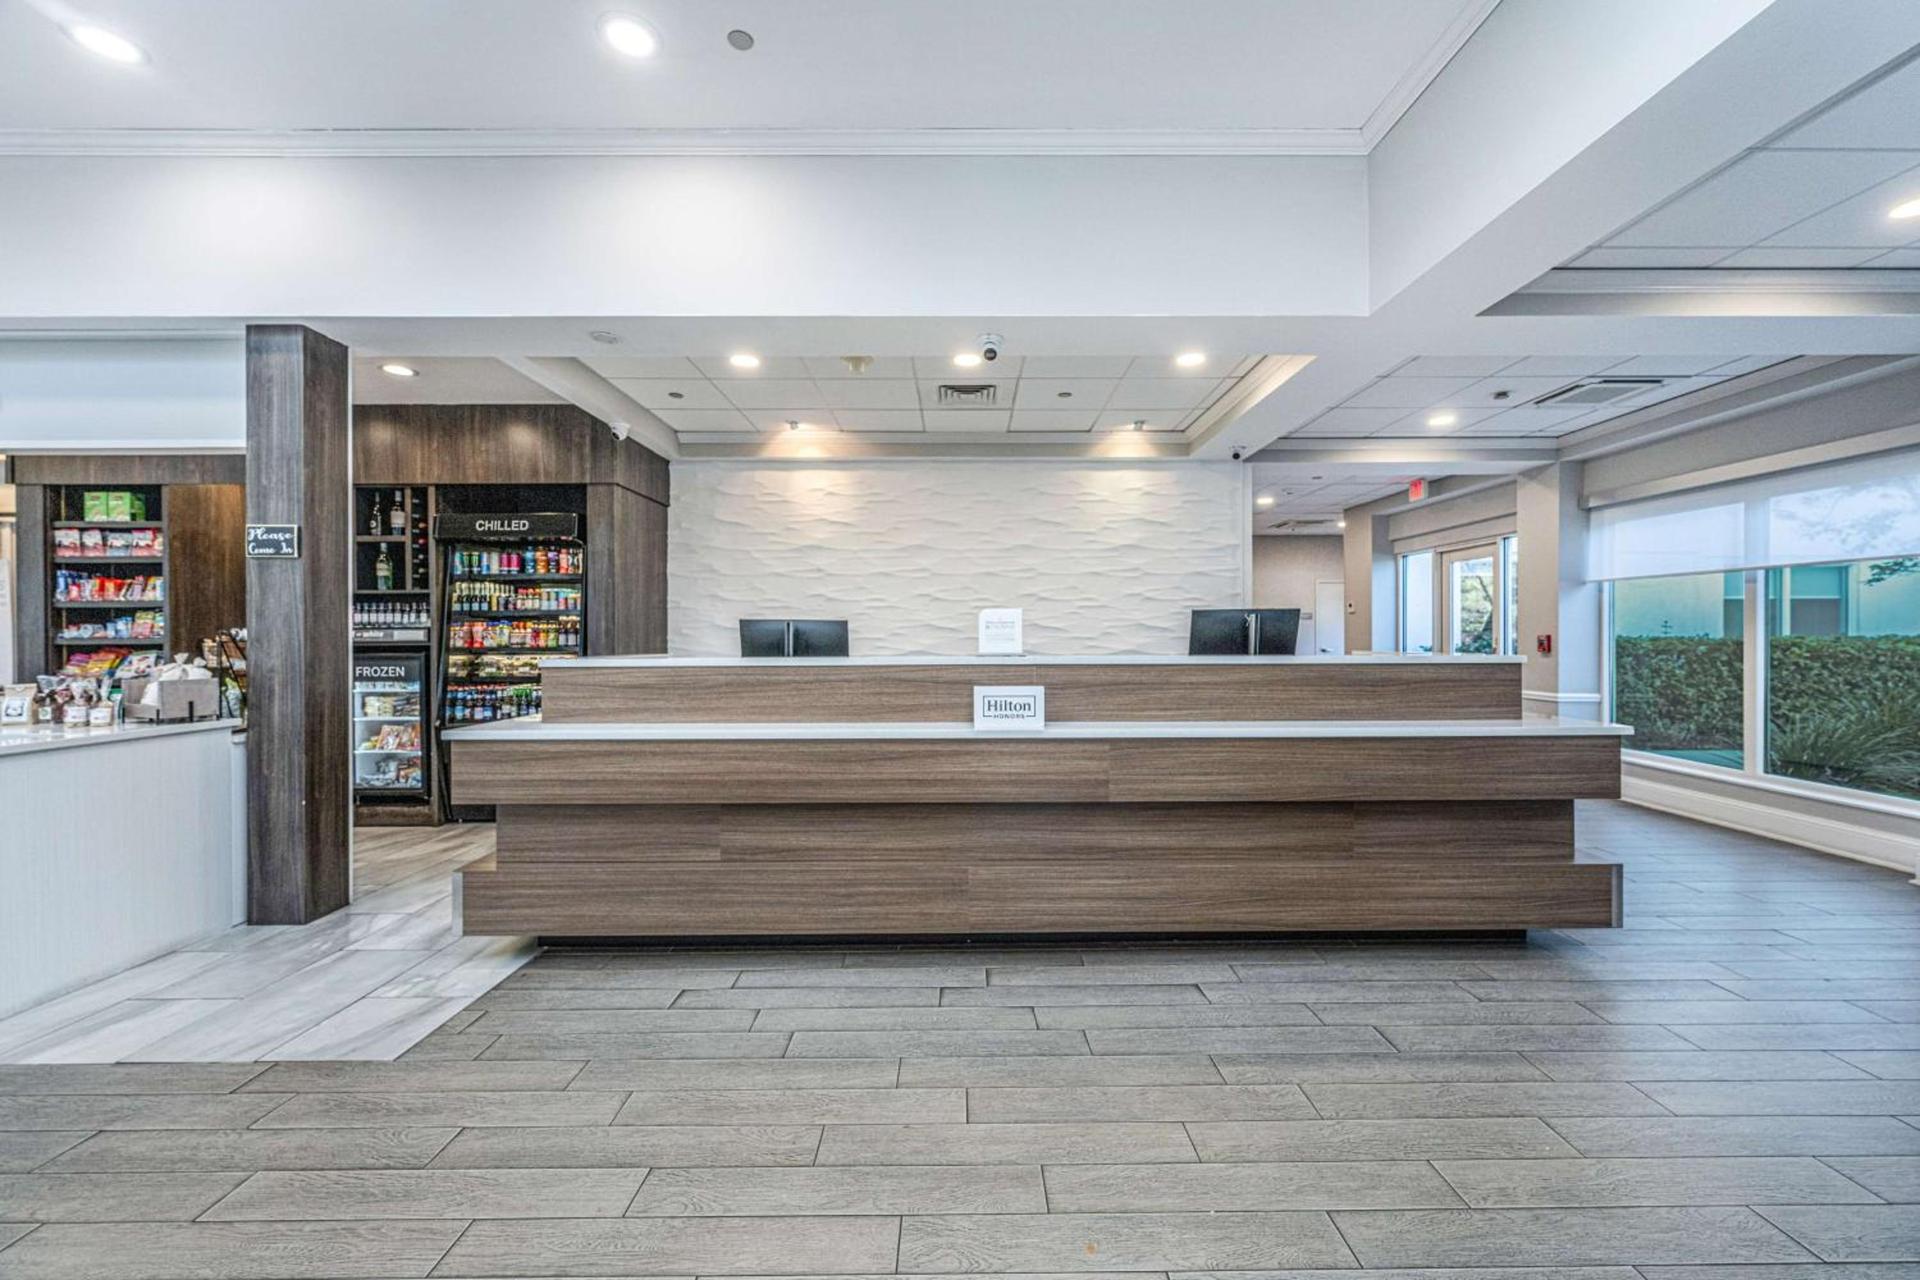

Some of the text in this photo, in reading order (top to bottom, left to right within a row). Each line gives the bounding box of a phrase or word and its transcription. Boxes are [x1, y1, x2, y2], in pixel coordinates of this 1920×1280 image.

[475, 519, 530, 531] CHILLED
[248, 527, 294, 541] Please
[248, 542, 294, 554] Come In
[355, 666, 405, 677] FROZEN
[987, 699, 1031, 712] Hilton
